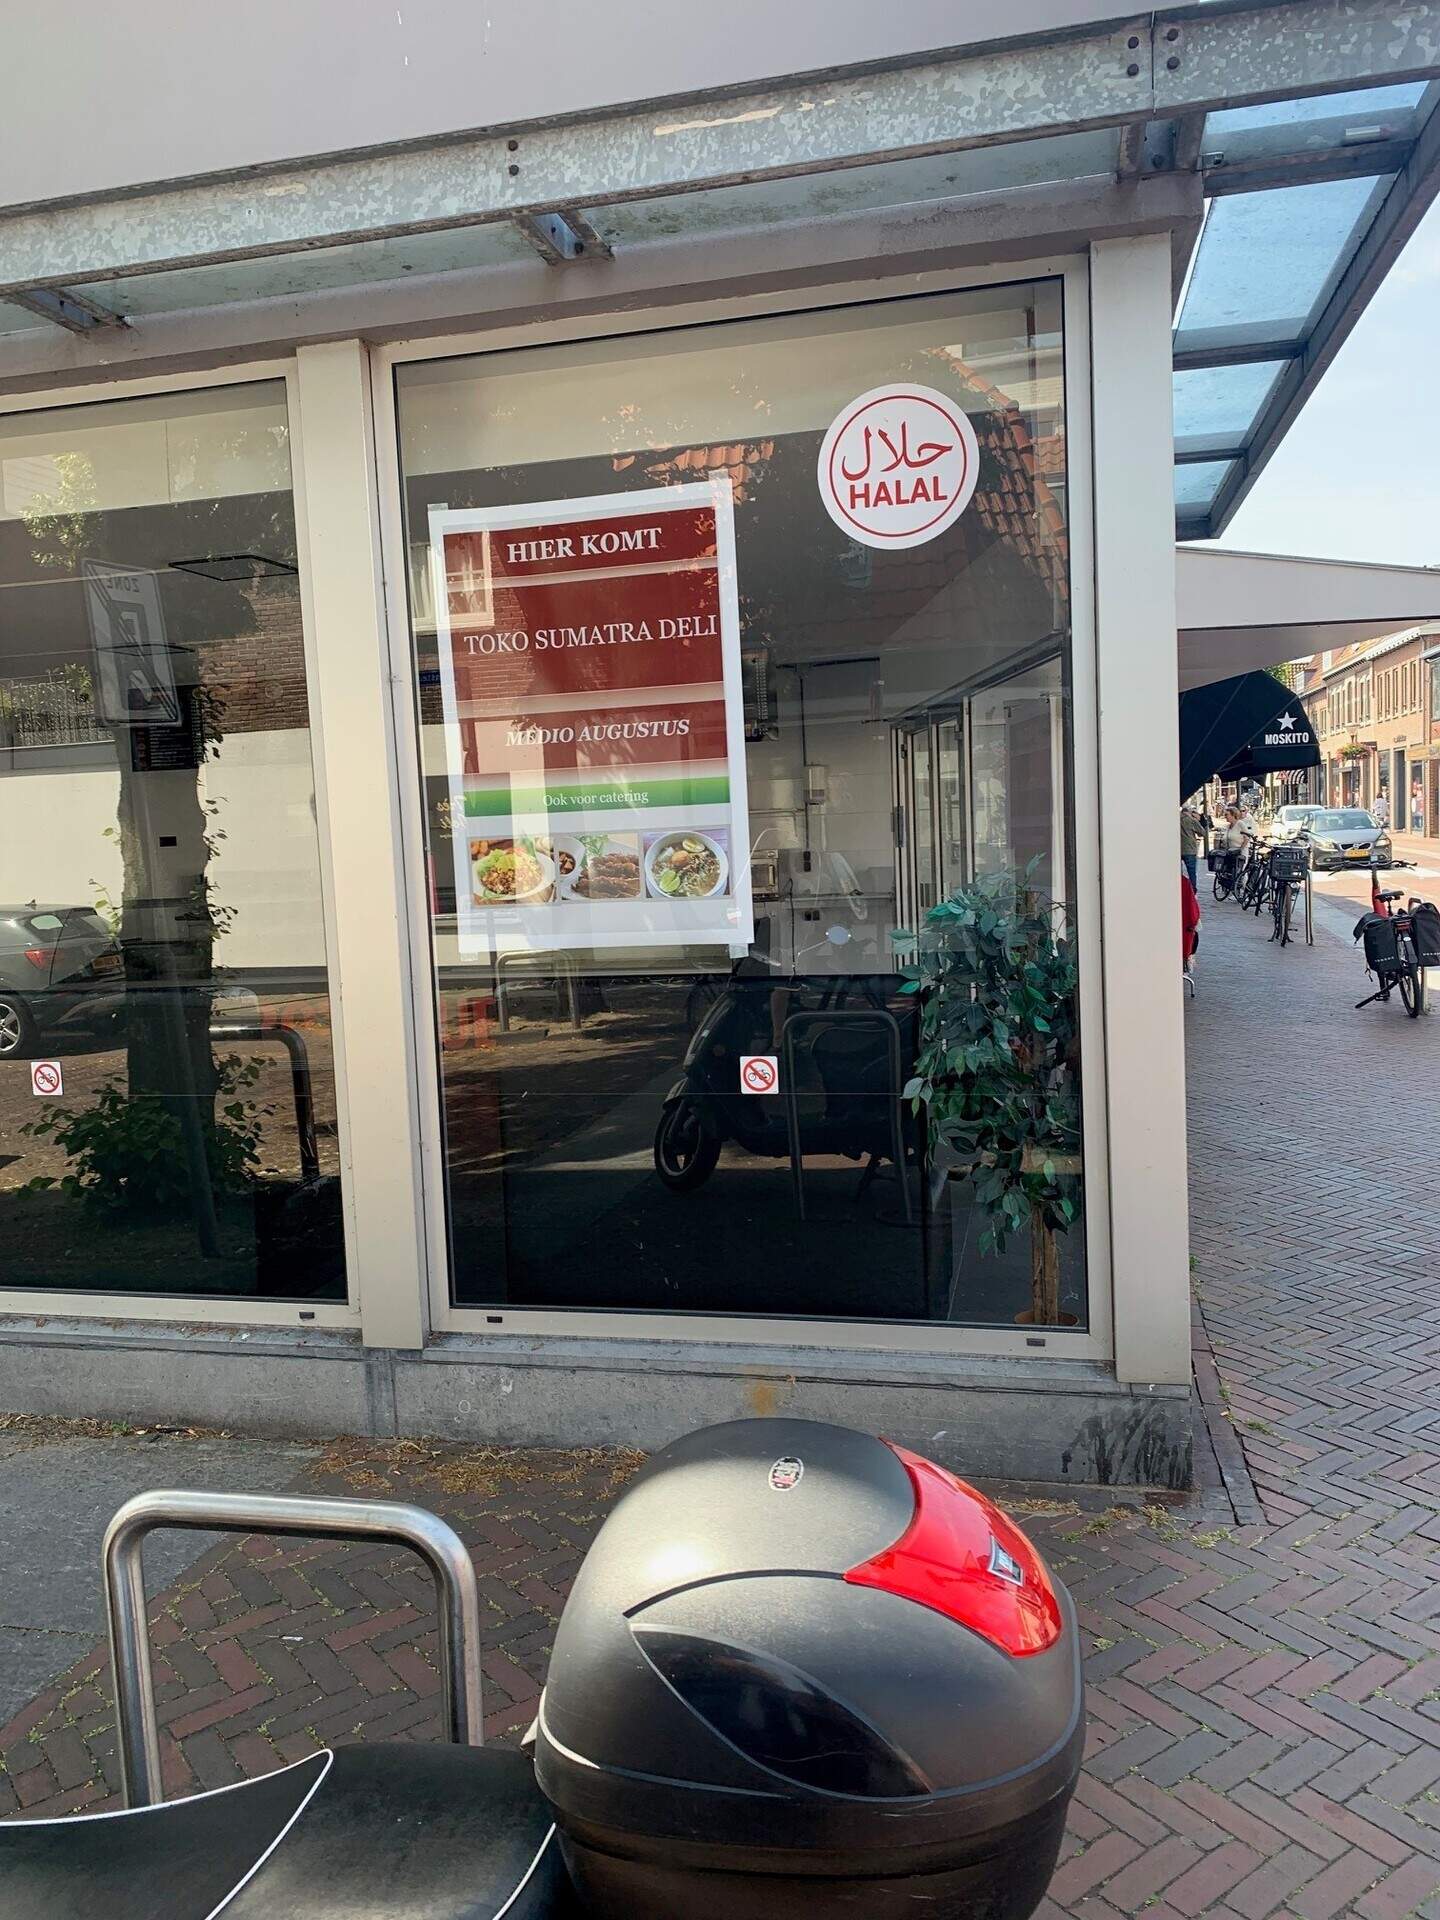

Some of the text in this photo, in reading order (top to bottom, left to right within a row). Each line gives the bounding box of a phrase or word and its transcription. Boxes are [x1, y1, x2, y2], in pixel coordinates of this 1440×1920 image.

[842, 421, 953, 481] حلال
[850, 476, 948, 509] HALAL
[507, 528, 662, 563] HIER KOMT
[463, 615, 718, 655] TOKO SUMATRA DELI
[504, 719, 690, 747] MEDIO AUGUSTUS
[1265, 732, 1309, 745] MOSKITO
[543, 790, 649, 807] Ook voor catering
